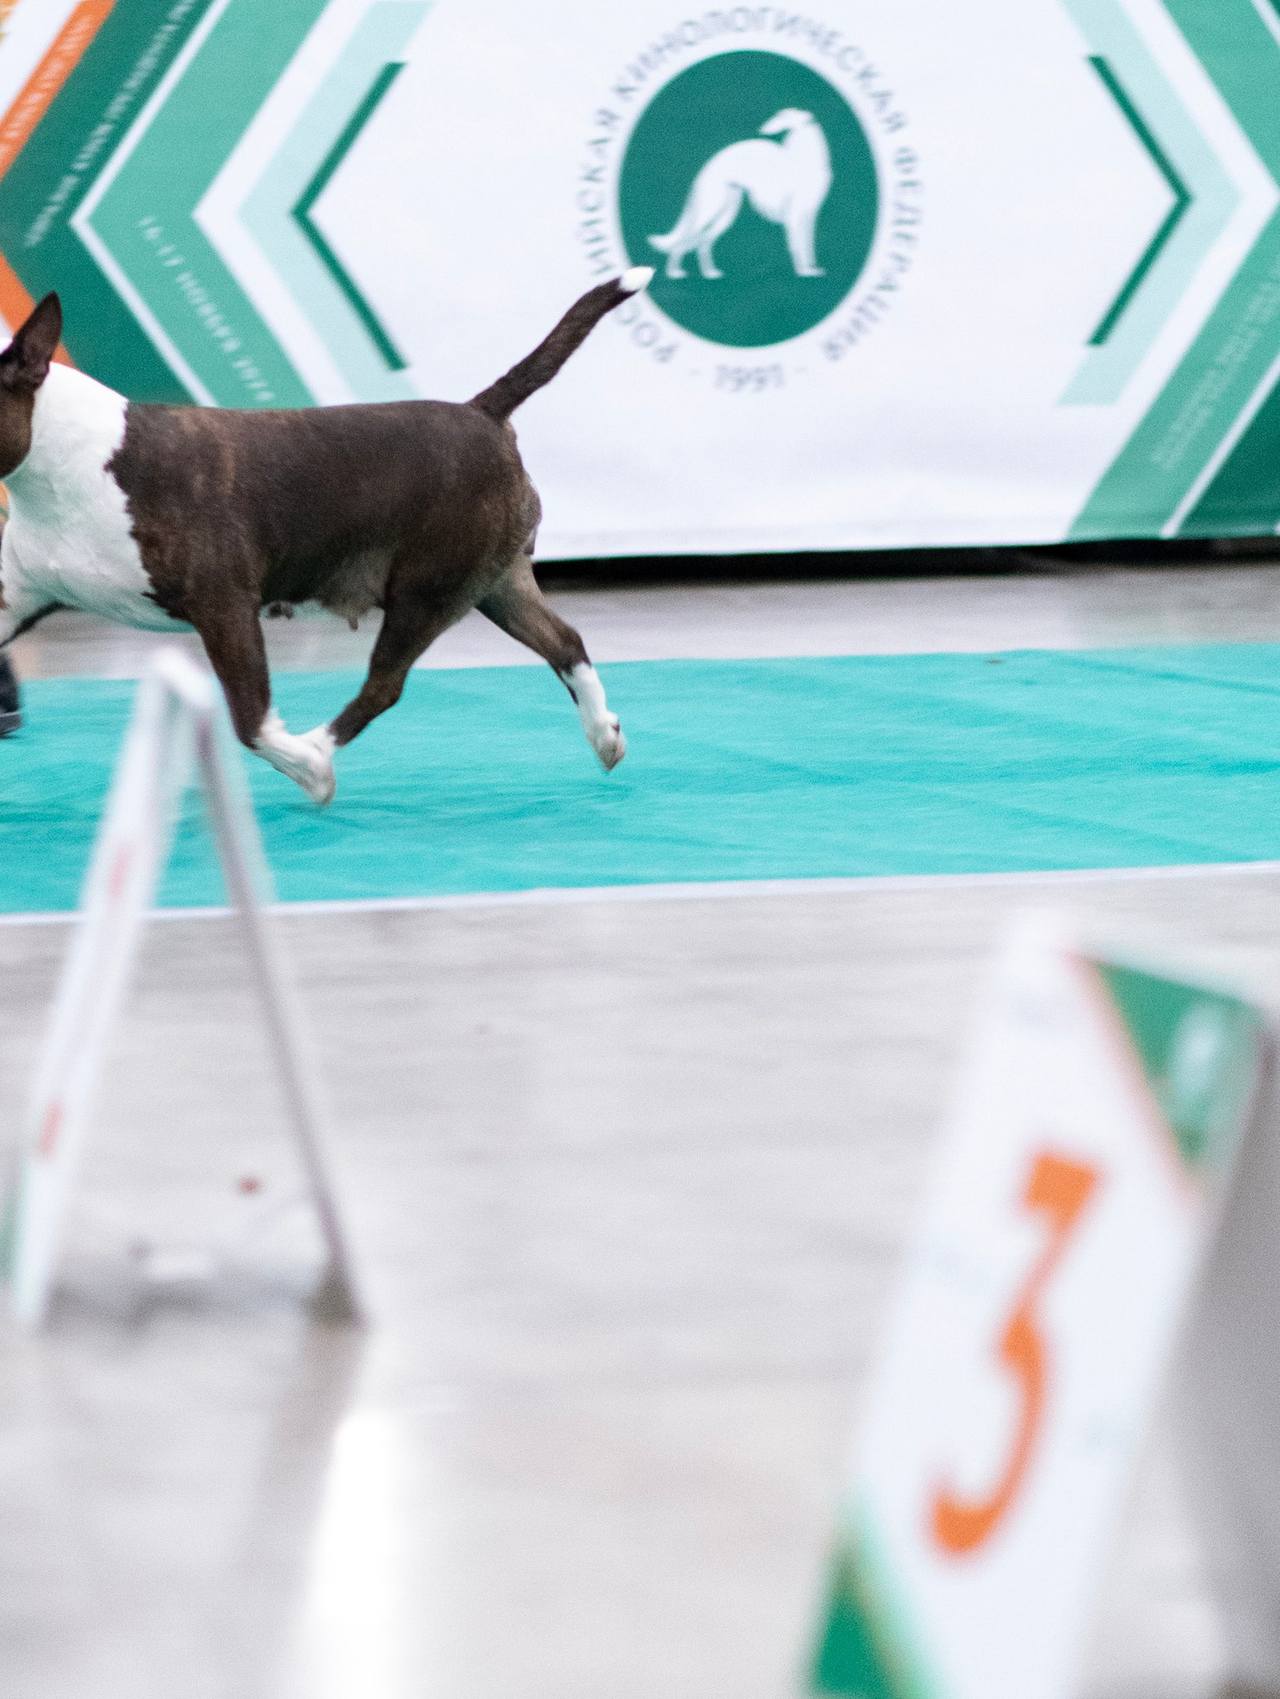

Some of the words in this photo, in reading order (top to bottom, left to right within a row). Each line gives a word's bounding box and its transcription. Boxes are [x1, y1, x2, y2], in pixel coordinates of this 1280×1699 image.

[610, 6, 909, 134] КИНОЛОГИЧЕСКАЯ
[575, 107, 679, 363] РОСИЙСКАЯ
[927, 1152, 1102, 1557] 3
